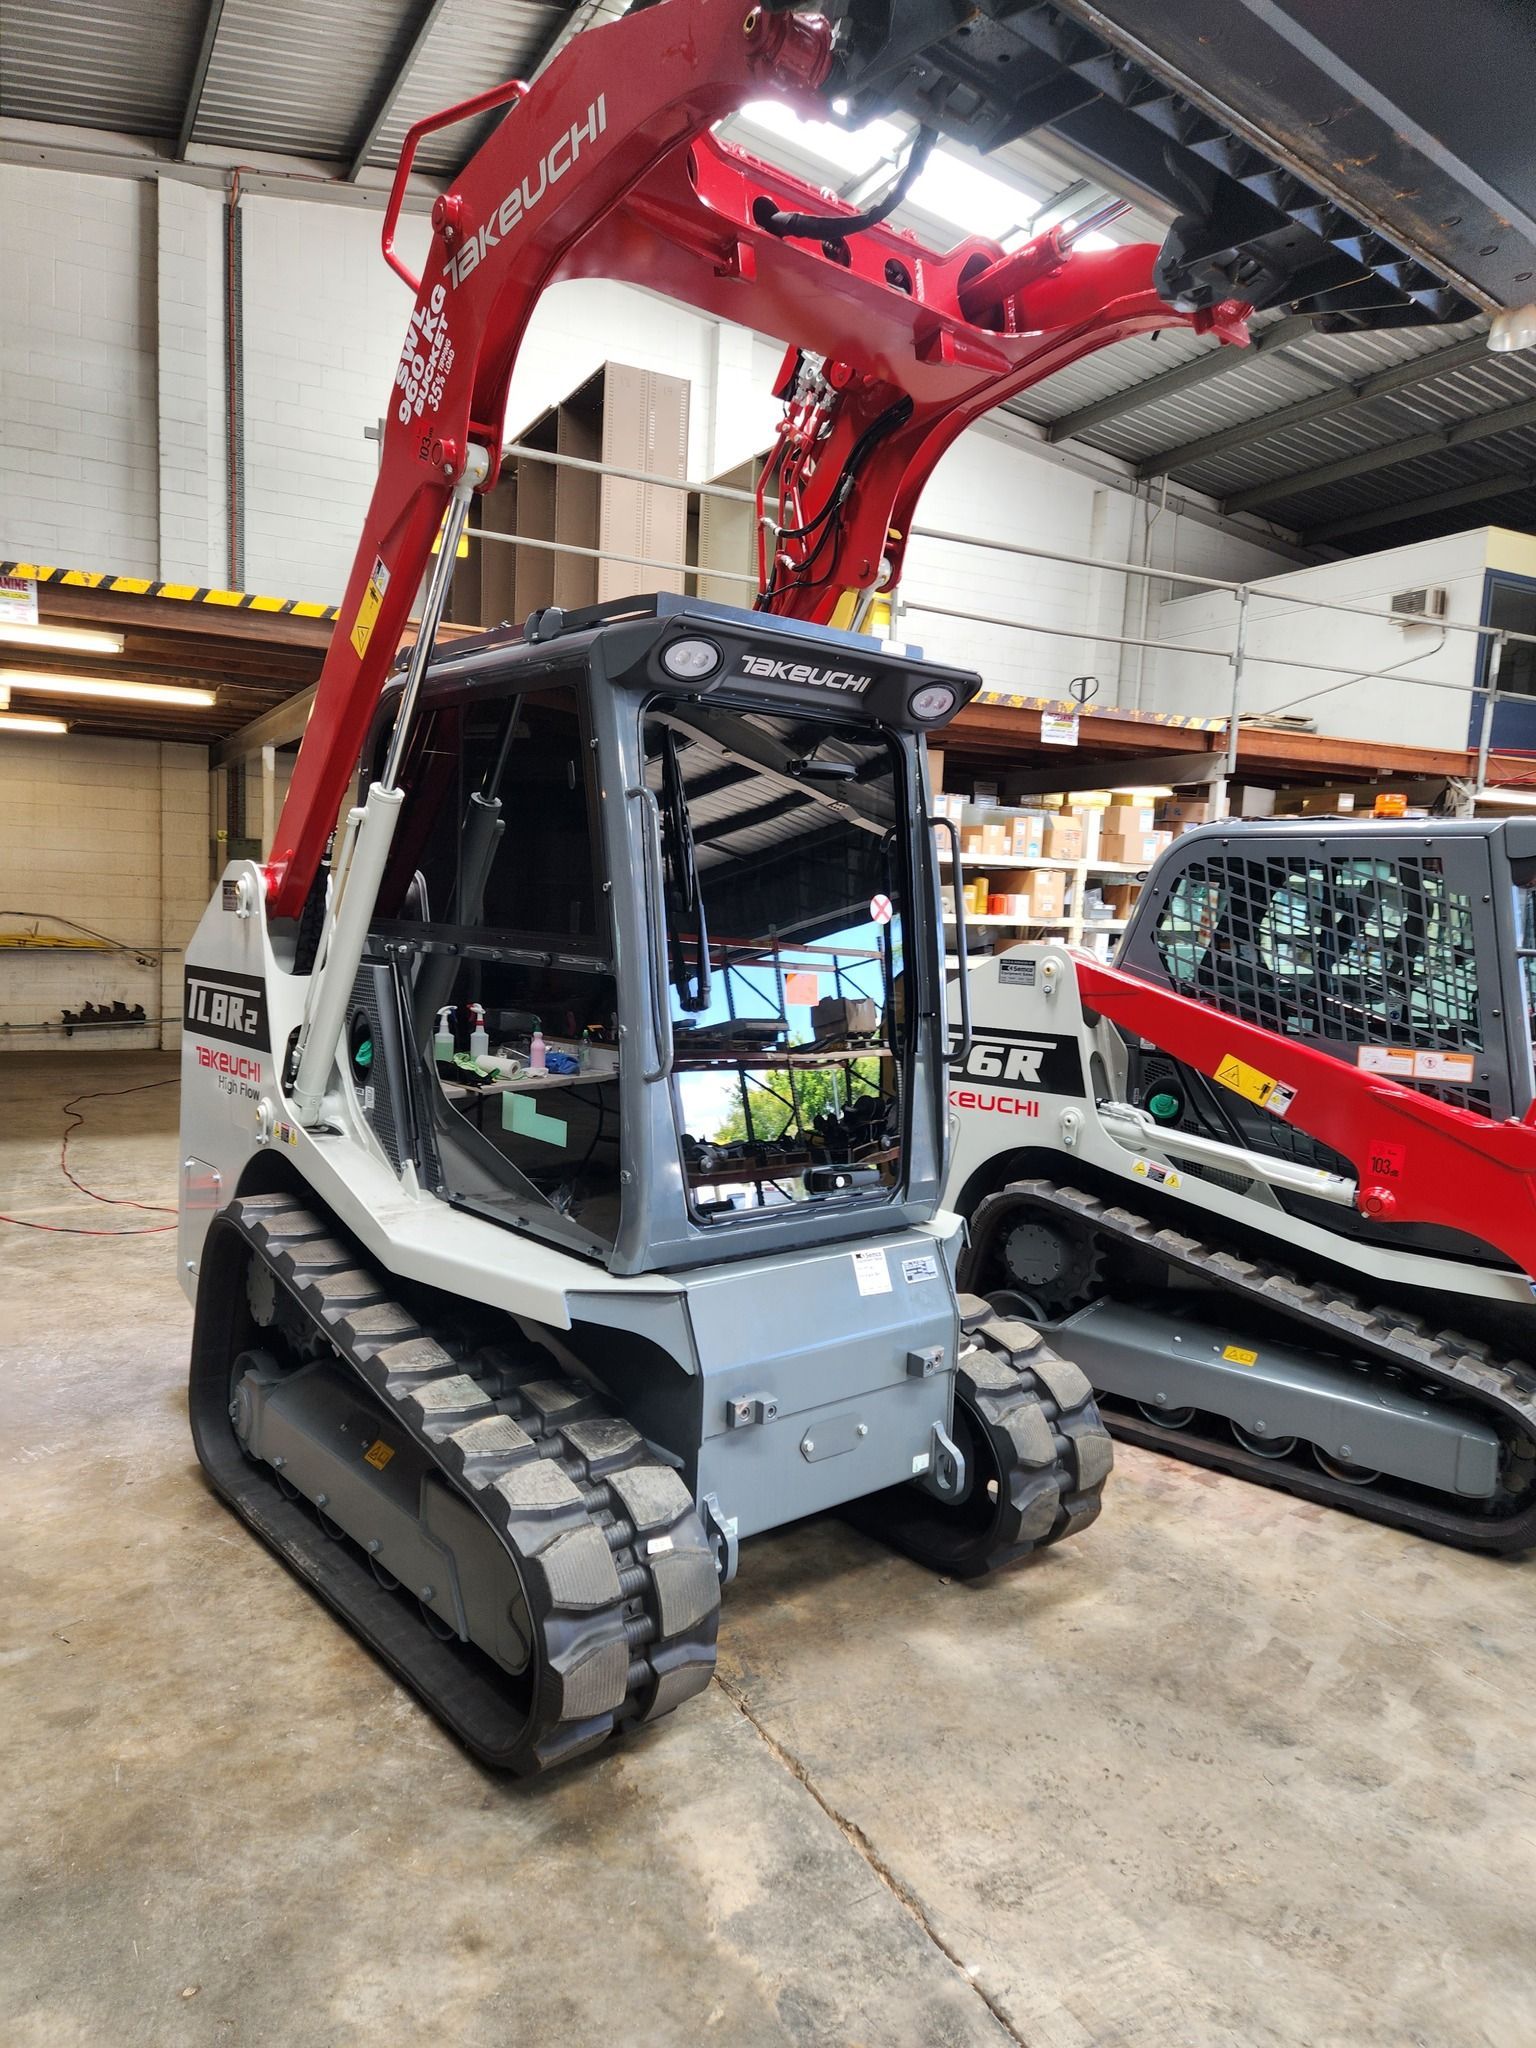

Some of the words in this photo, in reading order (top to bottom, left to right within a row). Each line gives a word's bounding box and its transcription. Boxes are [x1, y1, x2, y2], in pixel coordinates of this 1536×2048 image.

[443, 92, 607, 290] TAKEUCHI
[395, 306, 427, 389] SWL
[398, 354, 425, 425] 960
[422, 284, 447, 343] KG
[414, 313, 448, 417] BUCKET
[445, 349, 456, 375] LOAD
[428, 374, 446, 412] 35%
[438, 339, 452, 372] TIPPING
[418, 437, 432, 461] 103
[741, 655, 871, 692] TAKEUCHI
[196, 1046, 261, 1082] TAKEUCHI
[218, 1075, 238, 1095] High
[240, 1082, 260, 1101] Flow
[1372, 1156, 1391, 1175] 103
